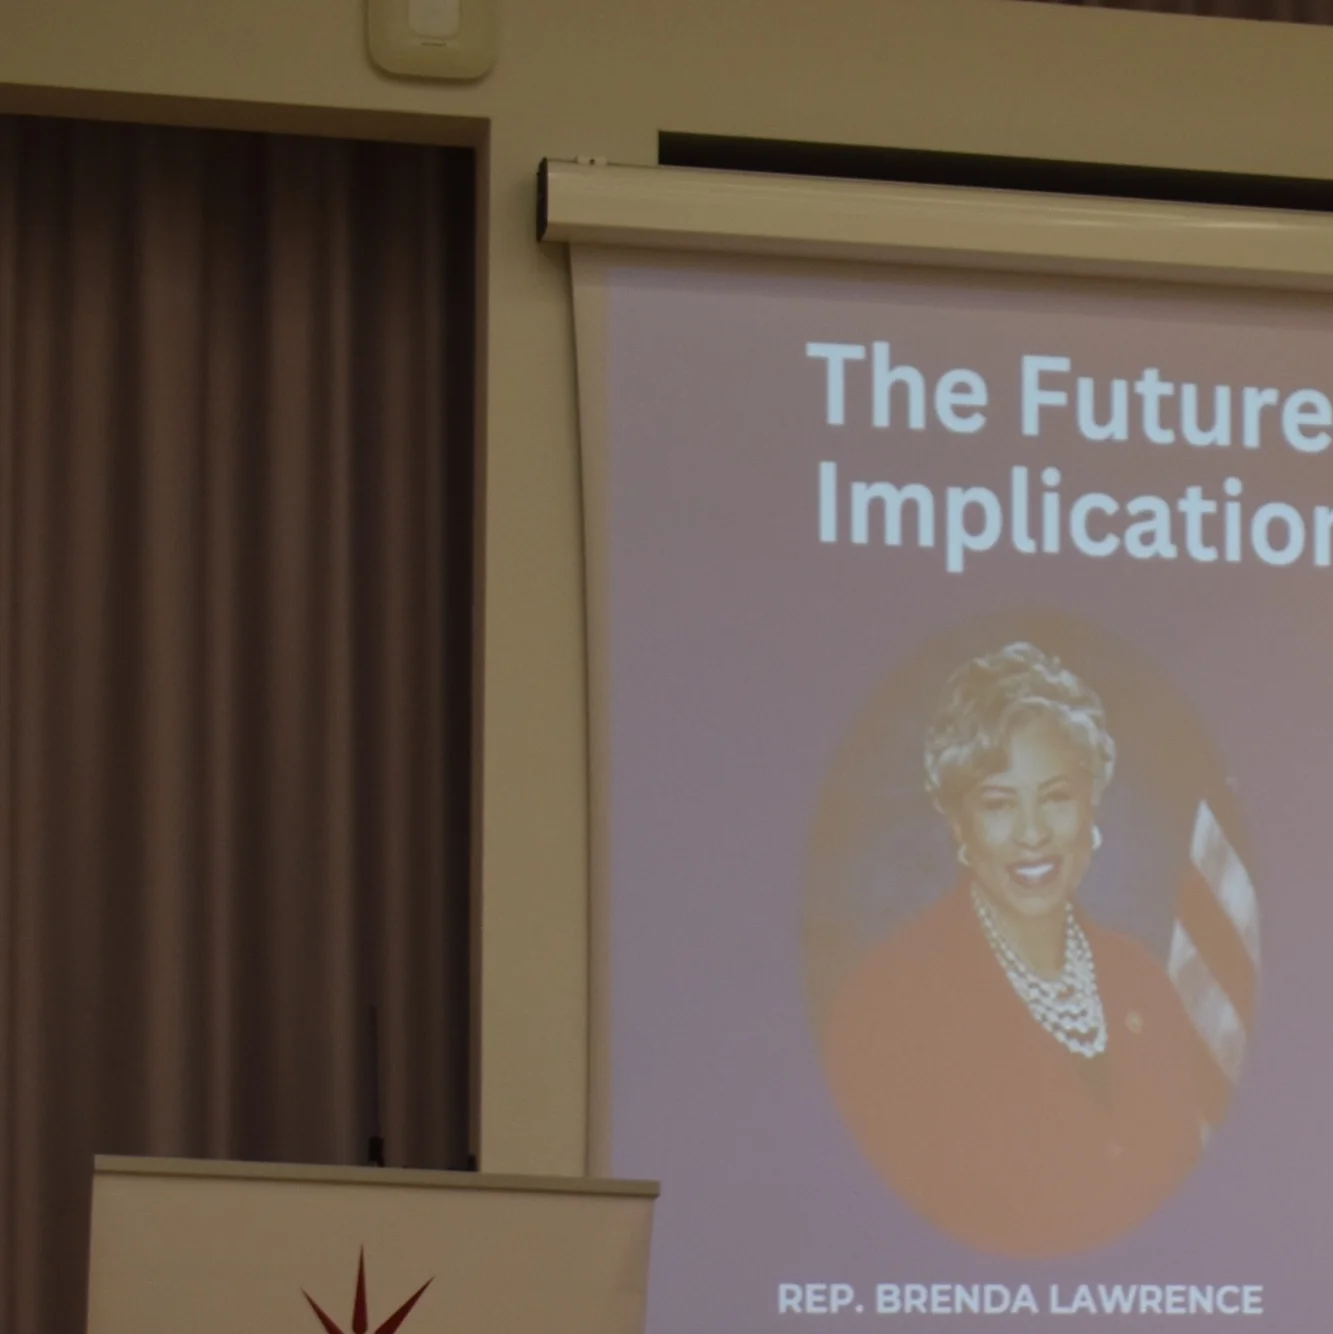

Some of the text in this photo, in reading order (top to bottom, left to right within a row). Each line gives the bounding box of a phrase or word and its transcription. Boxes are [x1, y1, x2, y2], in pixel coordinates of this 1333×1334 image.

[807, 341, 988, 434] The
[1022, 355, 1333, 452] Future
[778, 1283, 1264, 1315] REP. BRENDA LAWRENCE
